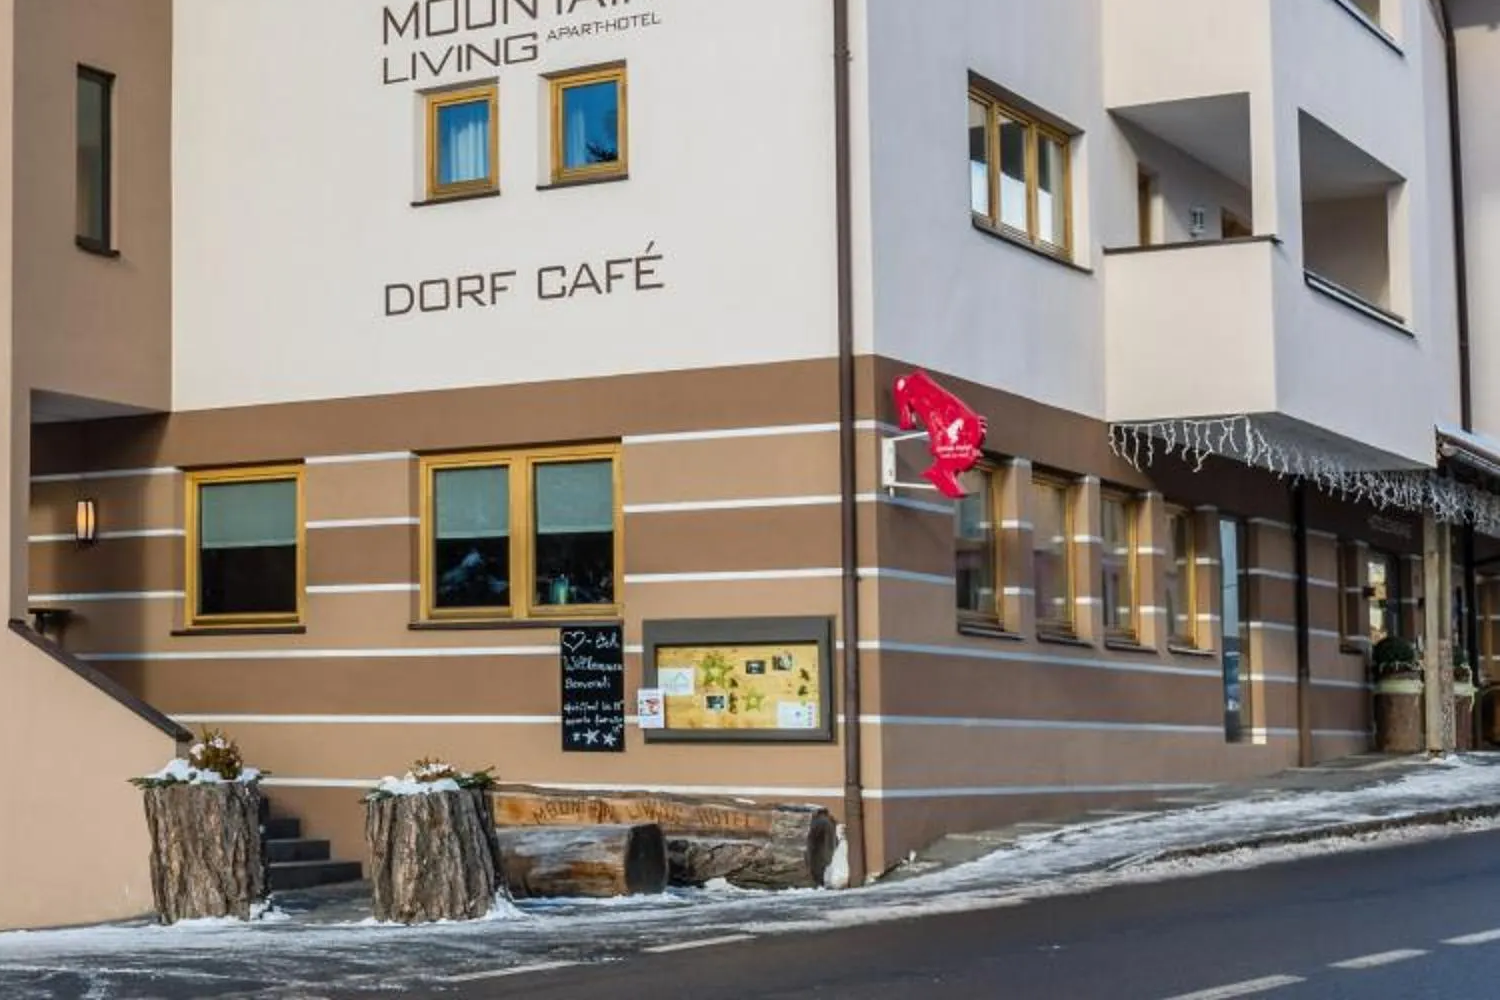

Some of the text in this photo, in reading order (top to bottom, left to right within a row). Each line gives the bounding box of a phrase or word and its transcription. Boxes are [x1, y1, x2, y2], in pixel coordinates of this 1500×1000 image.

[383, 11, 662, 85] LIVING APART-HOTEL
[384, 240, 664, 317] DORF CAFÉ
